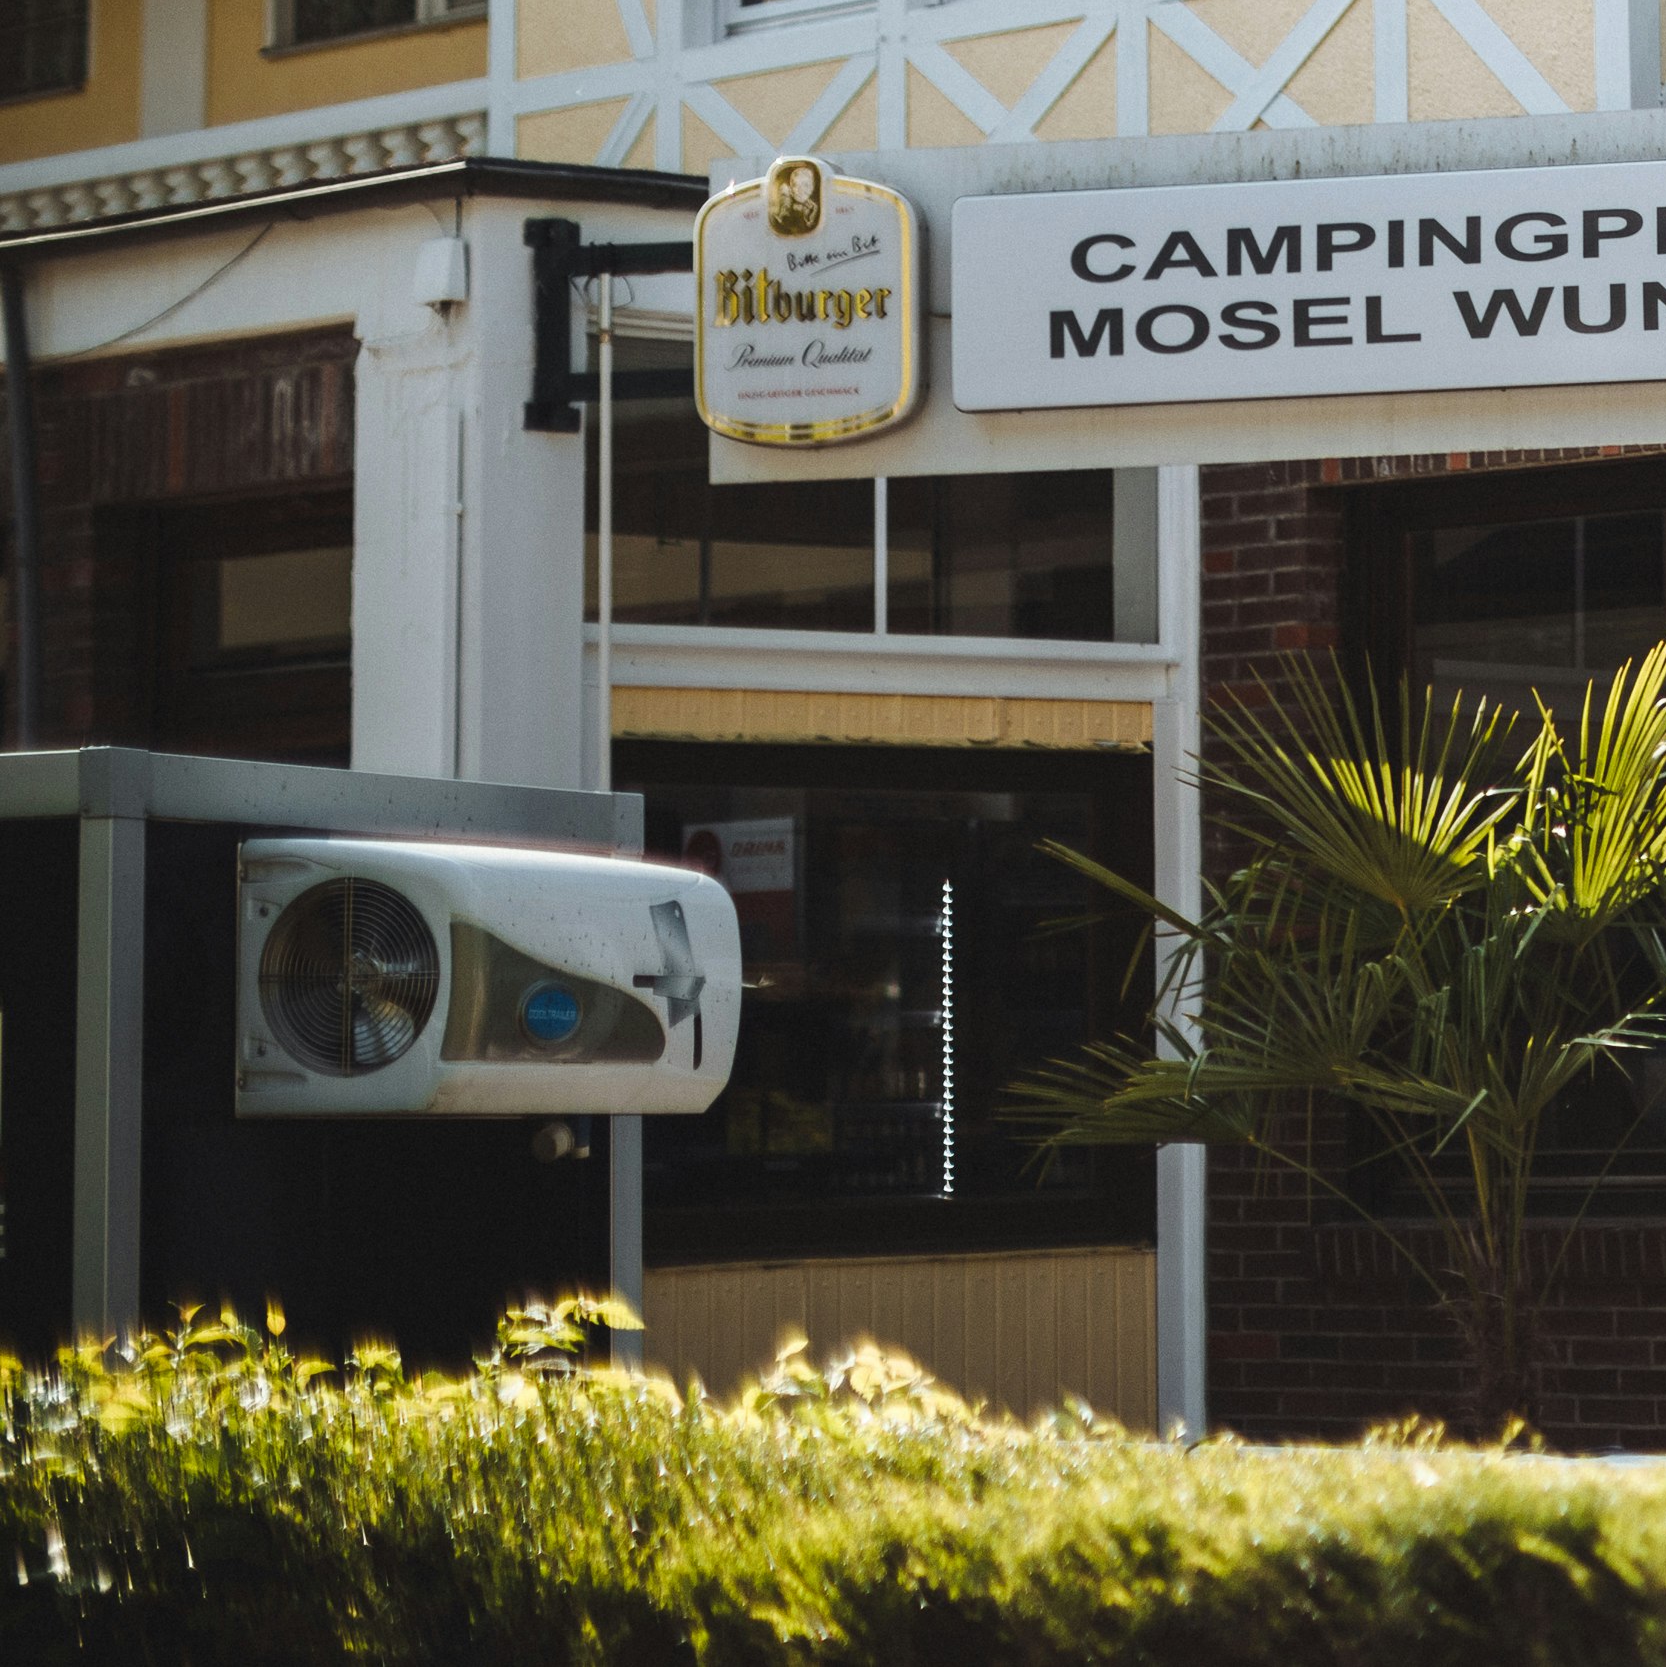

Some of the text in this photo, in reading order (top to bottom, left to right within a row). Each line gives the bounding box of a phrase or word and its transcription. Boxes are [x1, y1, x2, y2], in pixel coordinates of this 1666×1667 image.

[786, 251, 820, 272] Bitte
[851, 234, 881, 253] Bit
[714, 267, 892, 330] Bitburger
[1049, 296, 1422, 360] MOSEL
[725, 342, 795, 371] Premium
